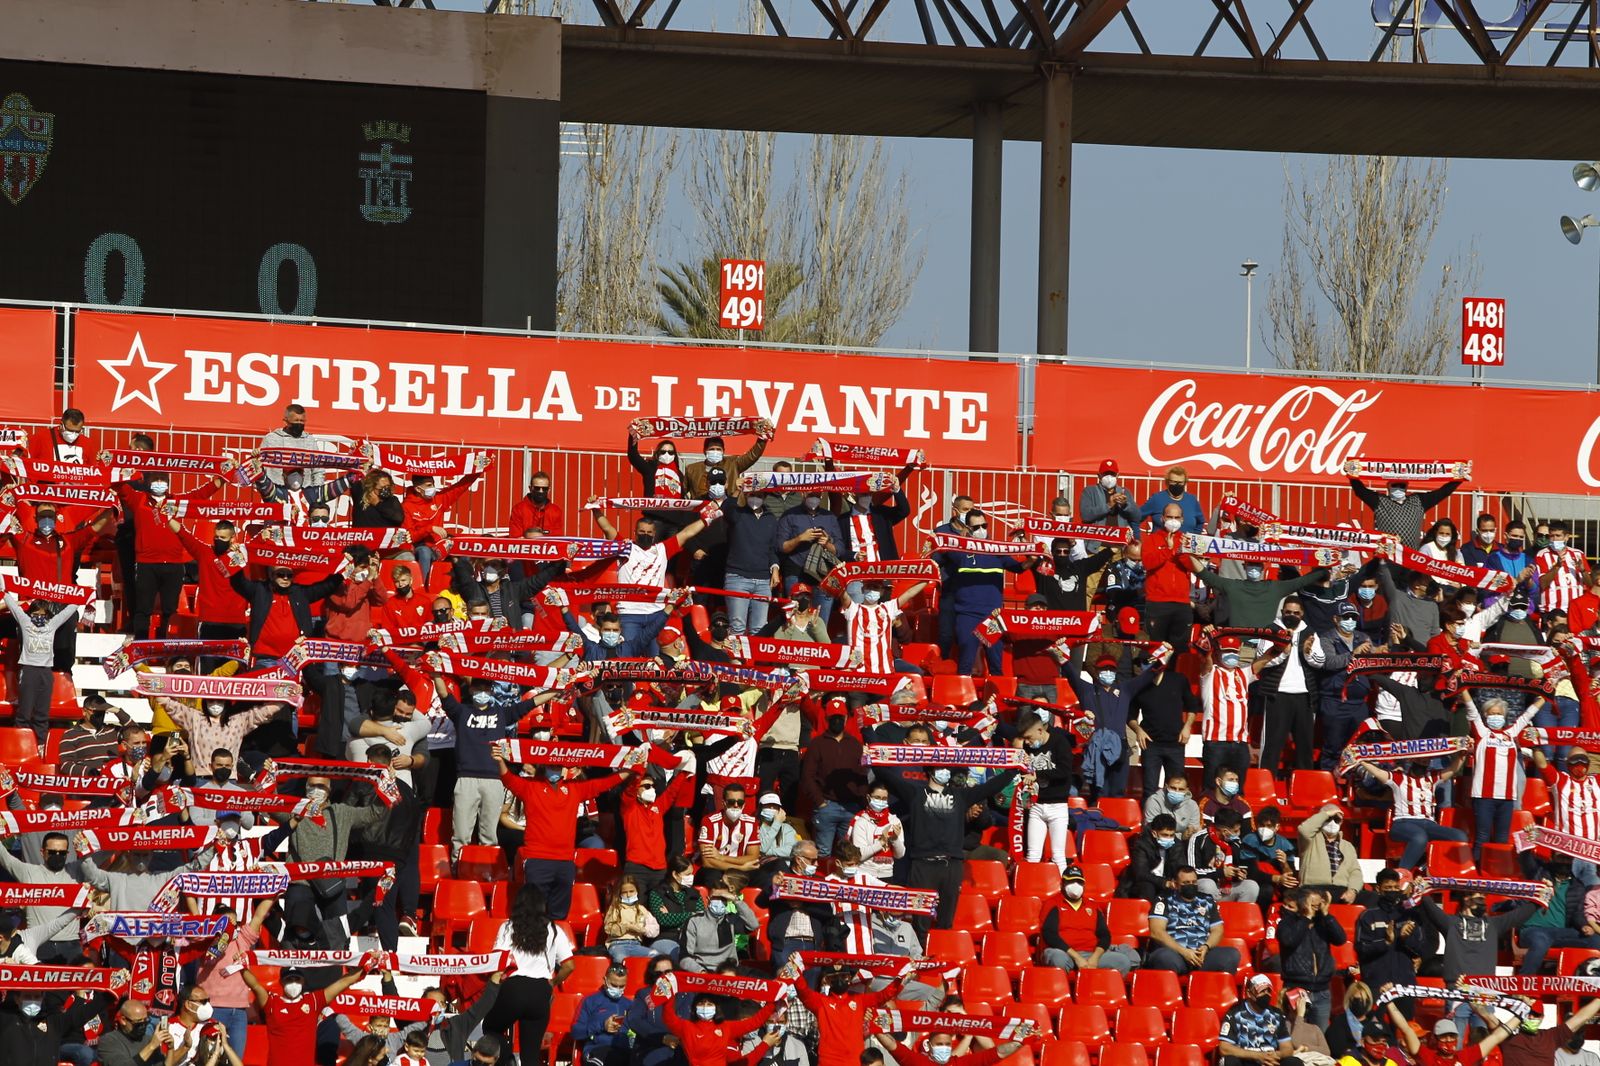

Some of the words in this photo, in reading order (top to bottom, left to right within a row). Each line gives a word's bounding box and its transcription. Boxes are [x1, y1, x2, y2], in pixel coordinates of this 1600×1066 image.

[84, 233, 145, 313] 0
[723, 263, 757, 291] 149
[258, 242, 318, 325] 0
[722, 296, 756, 326] 49
[1465, 302, 1498, 328] 148
[1464, 333, 1497, 362] 48
[184, 349, 583, 422] ESTRELLA
[595, 386, 641, 411] DE
[651, 375, 988, 441] LEVANTE
[1137, 379, 1383, 475] Coca-Cola
[33, 462, 50, 472] UD
[52, 464, 102, 476] ALMERÍA
[387, 453, 403, 466] UD
[406, 455, 456, 470] ALMERÍA
[302, 530, 319, 540] UD
[1410, 553, 1425, 564] UD
[1427, 558, 1475, 579] ALMERÍA
[1011, 615, 1028, 625] UD
[1030, 614, 1082, 626] ALMERÍA
[399, 627, 418, 638] UD
[759, 644, 776, 653] UD
[778, 645, 831, 659] ALMERÍA
[461, 658, 480, 670] UD
[482, 661, 537, 678] ALMERÍA
[819, 674, 835, 683] UD
[171, 680, 193, 692] UD
[199, 681, 267, 696] ALMERIA
[530, 746, 548, 756] UD
[549, 746, 605, 759] ALMERÍA
[27, 813, 46, 824] UD
[108, 832, 129, 842] UD
[132, 827, 195, 841] ALMERÍA
[1544, 832, 1562, 846] UD
[1013, 834, 1023, 853] UD
[298, 863, 319, 874] UD
[5, 886, 65, 899] ALMERÍA
[686, 976, 706, 985] UD
[708, 977, 768, 992] ALMERÍA
[1522, 977, 1539, 991] DE
[336, 994, 356, 1005] UD
[359, 995, 420, 1012] ALMERÍA
[912, 1015, 932, 1025] UD
[934, 1017, 993, 1030] ALMERÍA
